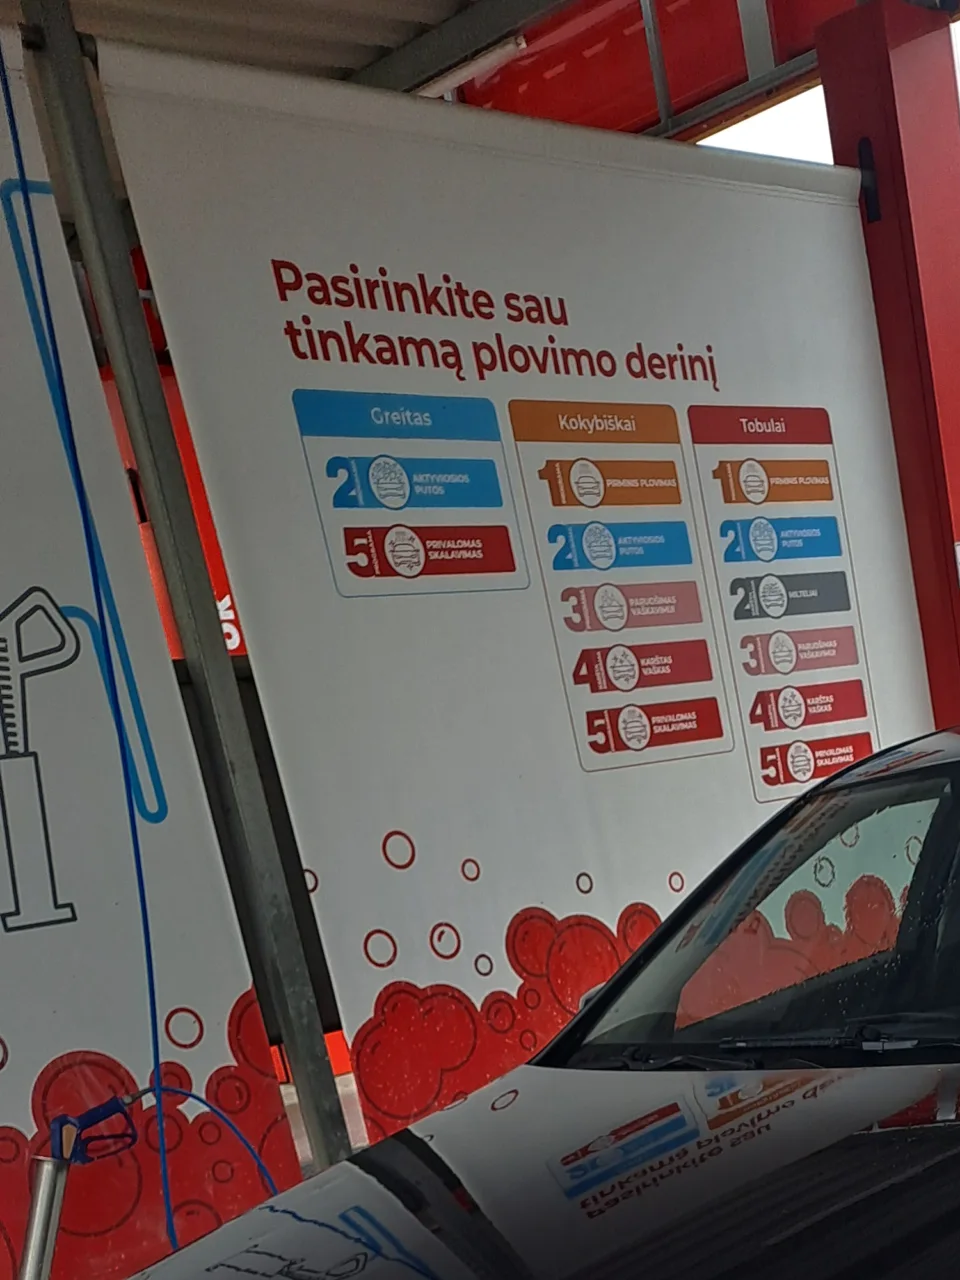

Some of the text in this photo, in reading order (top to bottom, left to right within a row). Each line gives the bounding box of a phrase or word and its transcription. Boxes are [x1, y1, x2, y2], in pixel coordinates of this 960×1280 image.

[270, 258, 569, 326] Pasirinkite sau
[283, 314, 720, 391] tinkamą plovimo derinį
[370, 407, 432, 426] Greitas
[558, 414, 636, 434] Kokybiškai
[739, 418, 786, 433] Tobulai
[326, 456, 361, 508] 2
[414, 485, 445, 495] PUTOS
[538, 460, 565, 506] 1
[712, 460, 733, 504] 1
[343, 527, 375, 577] 5
[426, 539, 482, 550] PRIVALOMAS
[428, 549, 483, 560] SKALAVIMAS
[547, 524, 577, 570] 2
[719, 520, 744, 562] 2
[560, 586, 588, 632] 3
[730, 577, 756, 620] 2
[572, 649, 601, 693] 4
[740, 635, 763, 676] 3
[750, 690, 774, 731] 4
[586, 711, 612, 754] 5
[760, 747, 781, 786] 5
